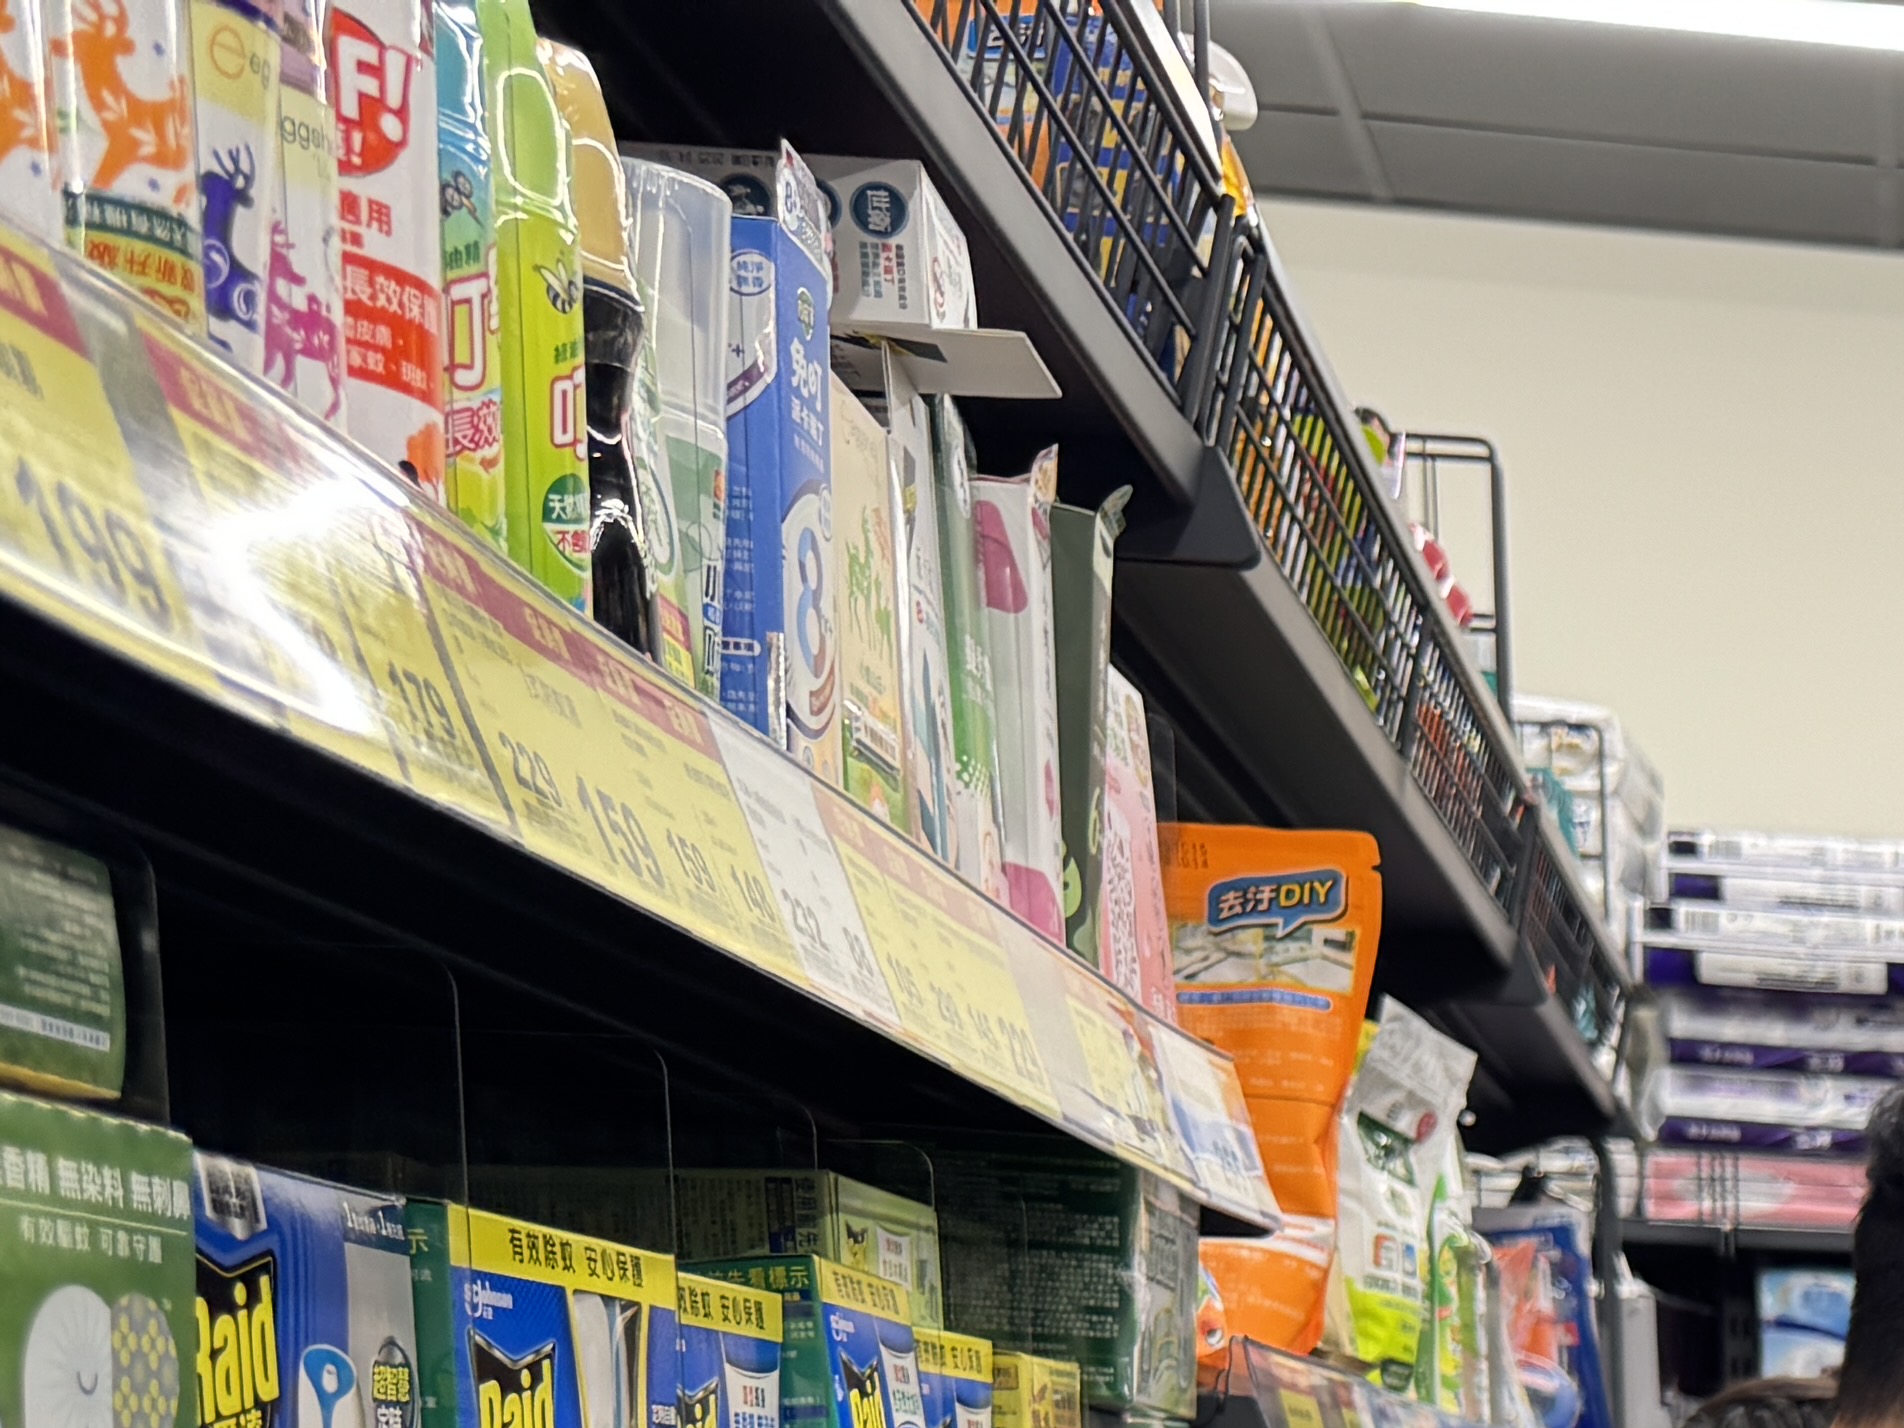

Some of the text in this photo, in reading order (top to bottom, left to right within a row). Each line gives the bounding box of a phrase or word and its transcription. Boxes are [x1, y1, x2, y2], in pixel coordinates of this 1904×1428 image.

[57, 1154, 126, 1206] 無染料
[508, 1226, 644, 1289] 有效除蚊 安心保護
[196, 1274, 280, 1428] Raid
